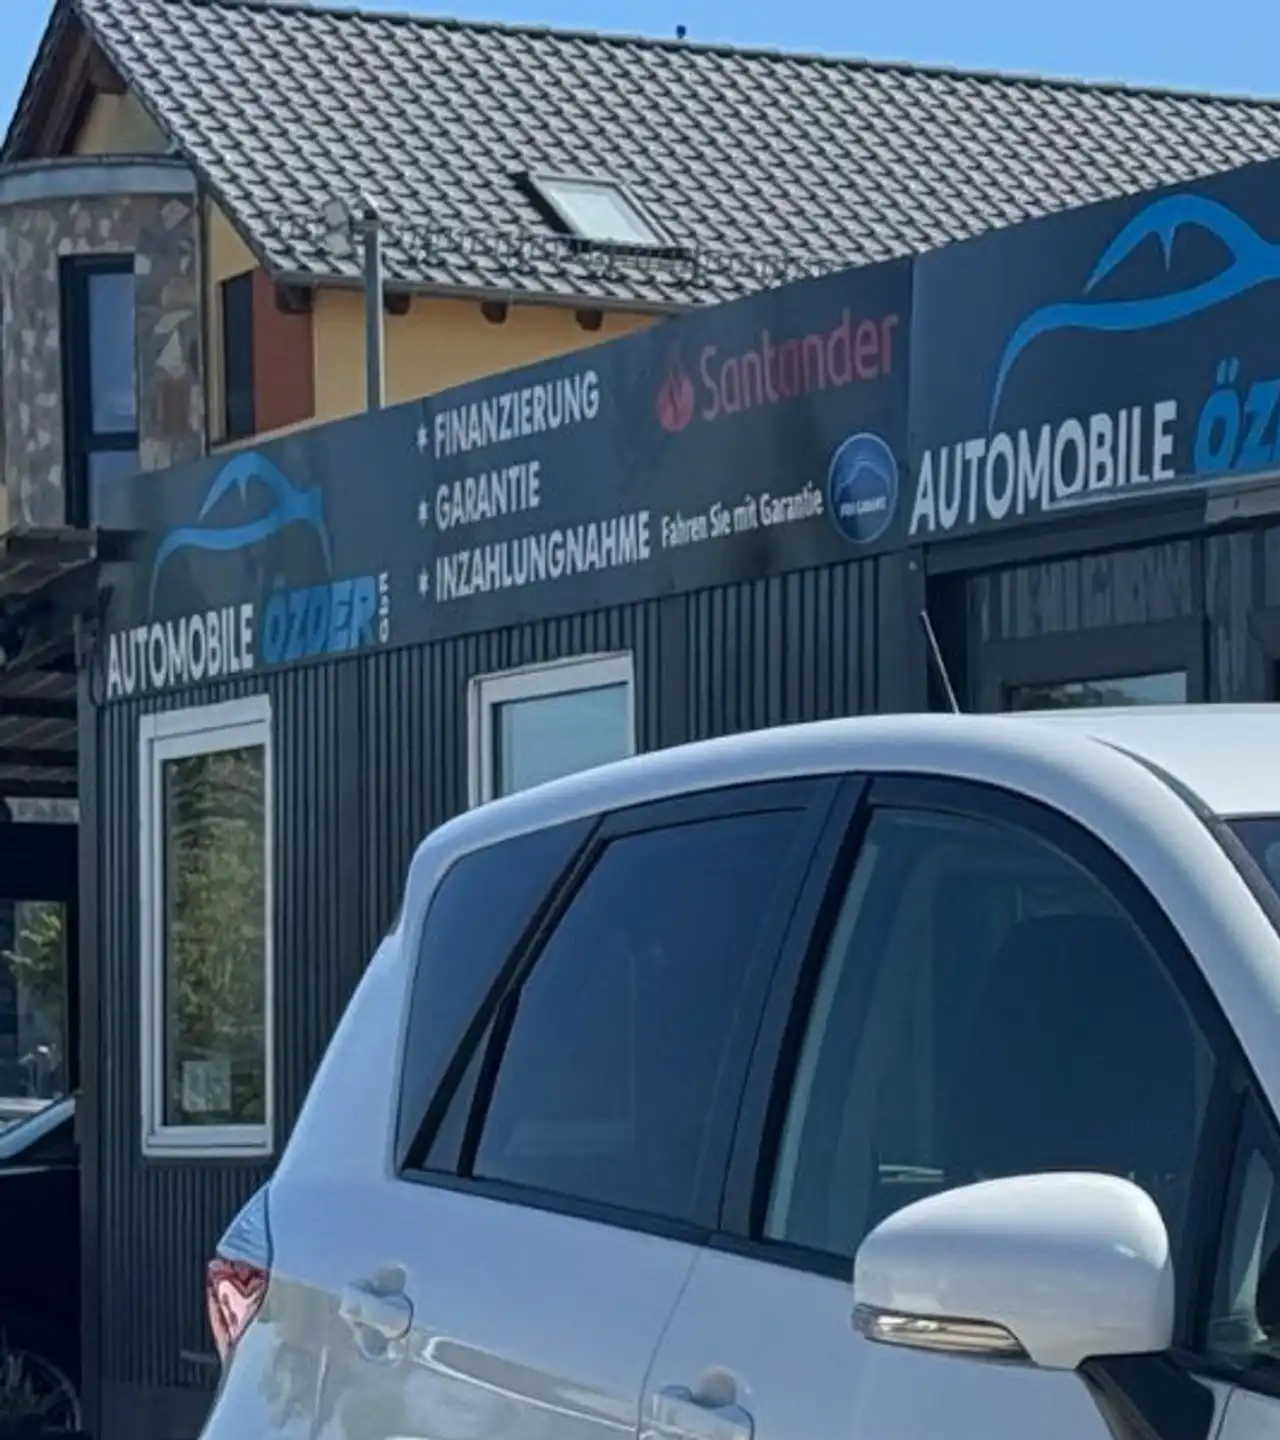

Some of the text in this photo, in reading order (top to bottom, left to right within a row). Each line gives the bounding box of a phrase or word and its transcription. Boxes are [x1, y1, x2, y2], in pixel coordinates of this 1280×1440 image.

[700, 307, 899, 422] Santander
[434, 369, 600, 459] FINANZIERUNG
[435, 460, 541, 531] GARANTIE
[661, 479, 825, 549] Fahren Sie mit Garantie
[908, 400, 1178, 537] AUTOMOBILE
[436, 510, 651, 603] INZAHLUNGNAHME
[106, 602, 255, 700] AUTOMOBILE
[263, 573, 377, 664] ÖZDER
